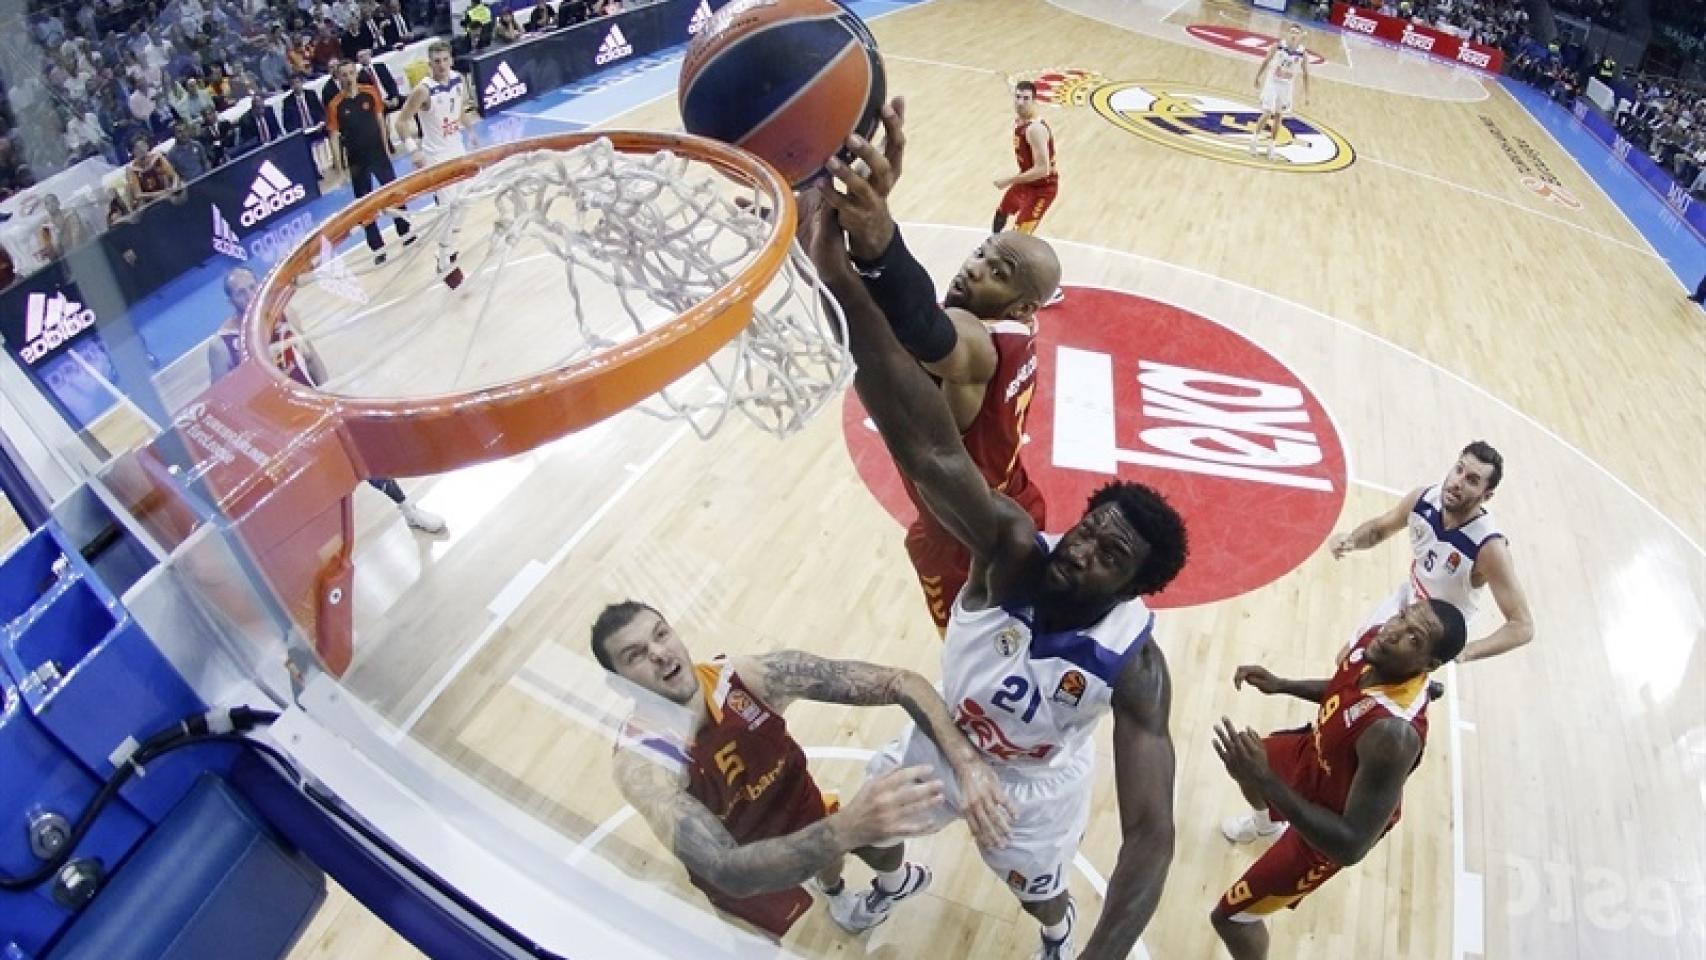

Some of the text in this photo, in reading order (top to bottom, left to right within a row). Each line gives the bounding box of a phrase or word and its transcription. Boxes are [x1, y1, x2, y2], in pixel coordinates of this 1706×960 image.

[595, 44, 634, 65] adidas
[484, 82, 528, 110] adidas
[241, 184, 306, 227] adidas
[1424, 549, 1438, 573] 5
[991, 675, 1042, 724] 21
[713, 740, 745, 787] 5
[1028, 863, 1063, 895] 21
